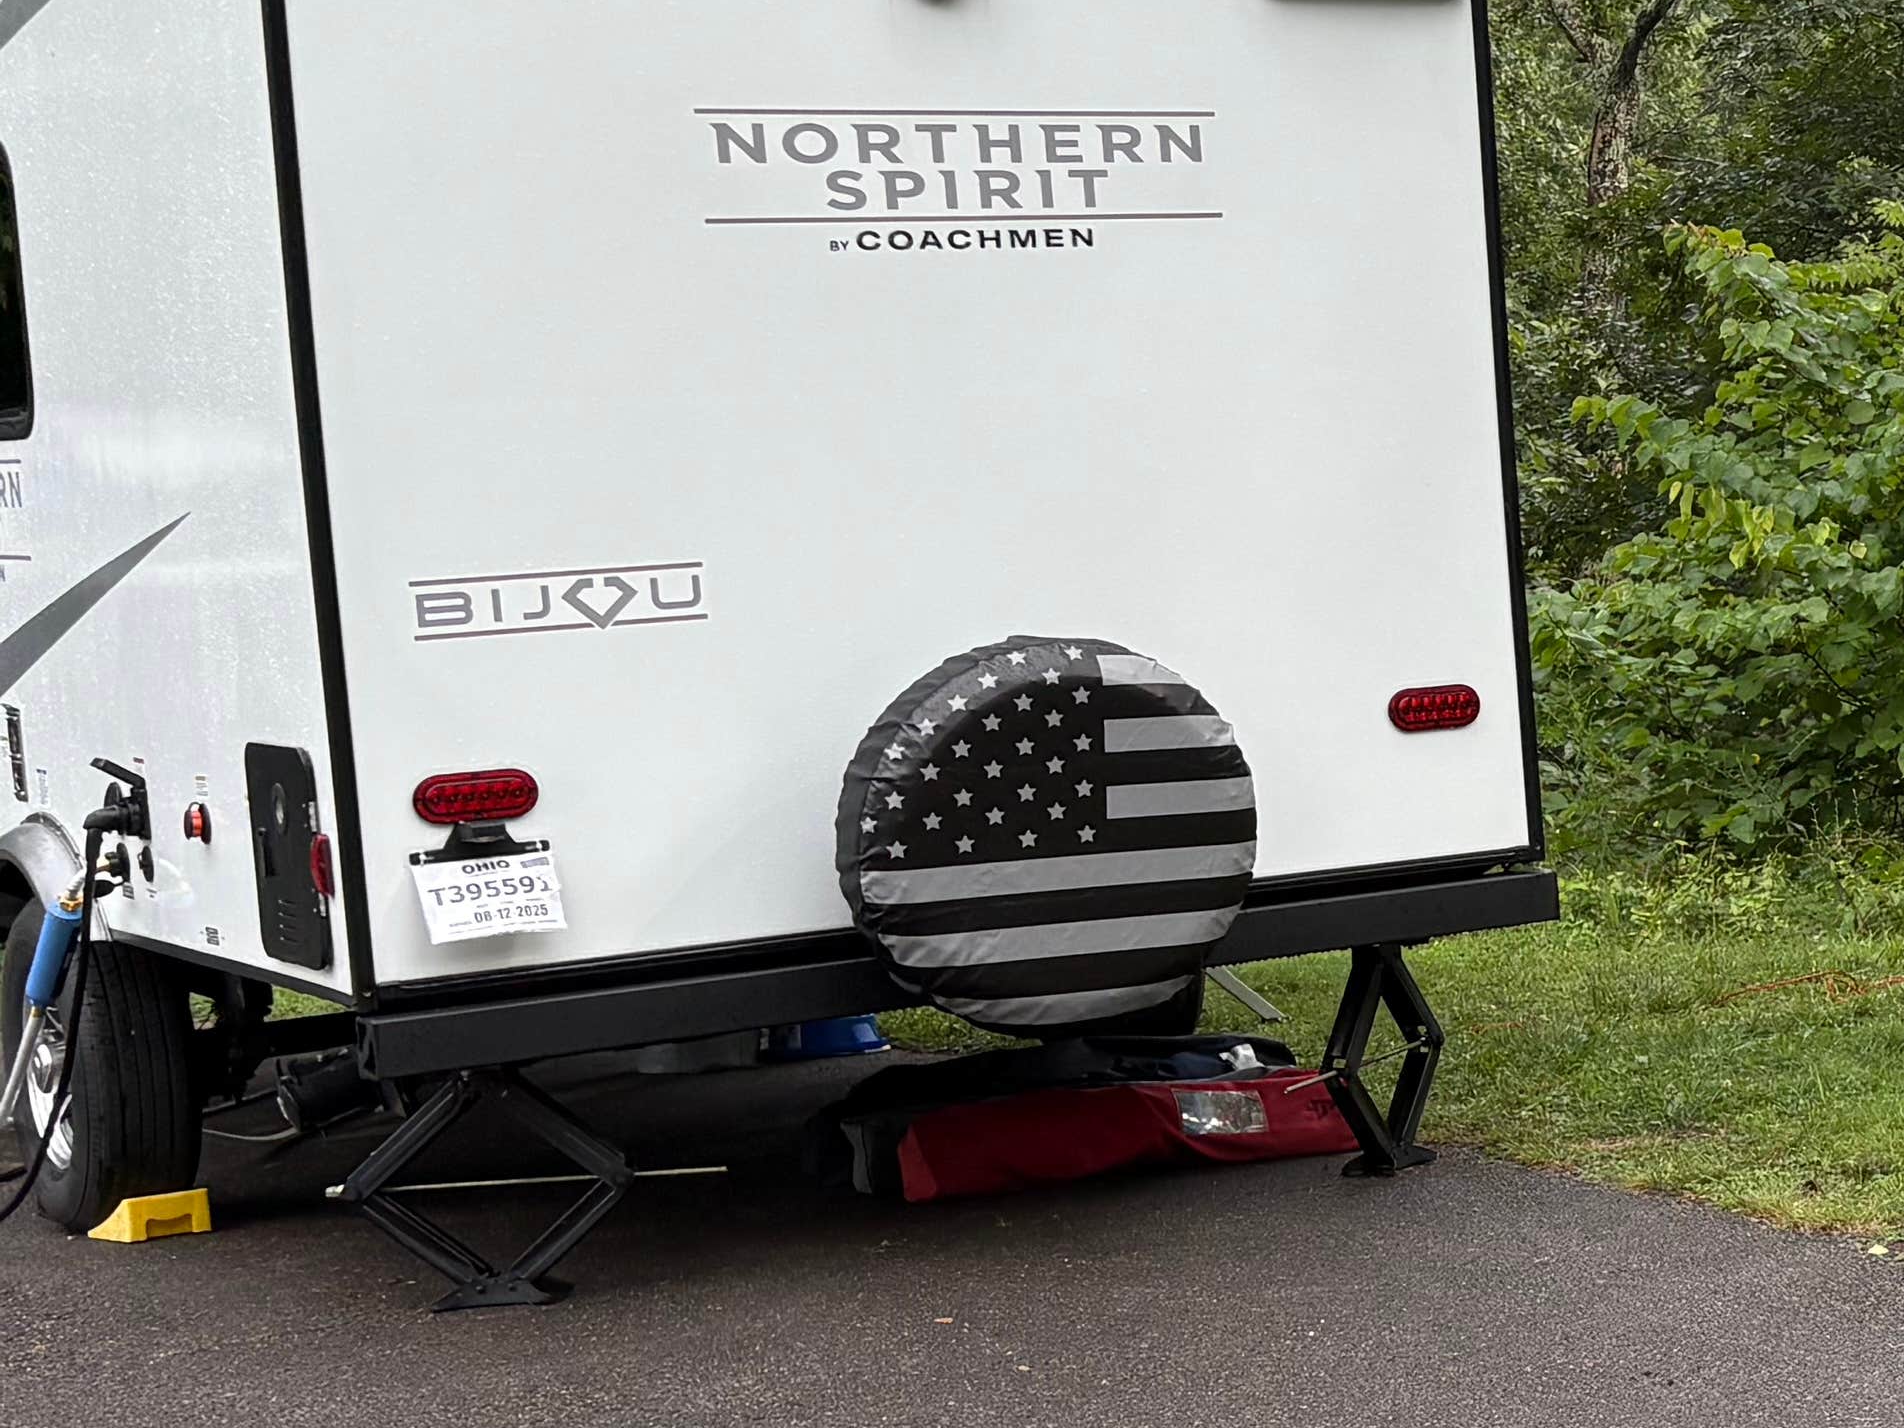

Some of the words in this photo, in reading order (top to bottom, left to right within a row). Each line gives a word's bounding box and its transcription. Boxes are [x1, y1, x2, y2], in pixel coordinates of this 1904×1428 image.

[709, 122, 1204, 165] NORTHERN
[825, 169, 1110, 212] SPIRIT
[829, 239, 850, 252] BY
[855, 227, 1095, 252] COACHMEN
[415, 574, 702, 630] BIJOU
[461, 859, 511, 875] OHIO
